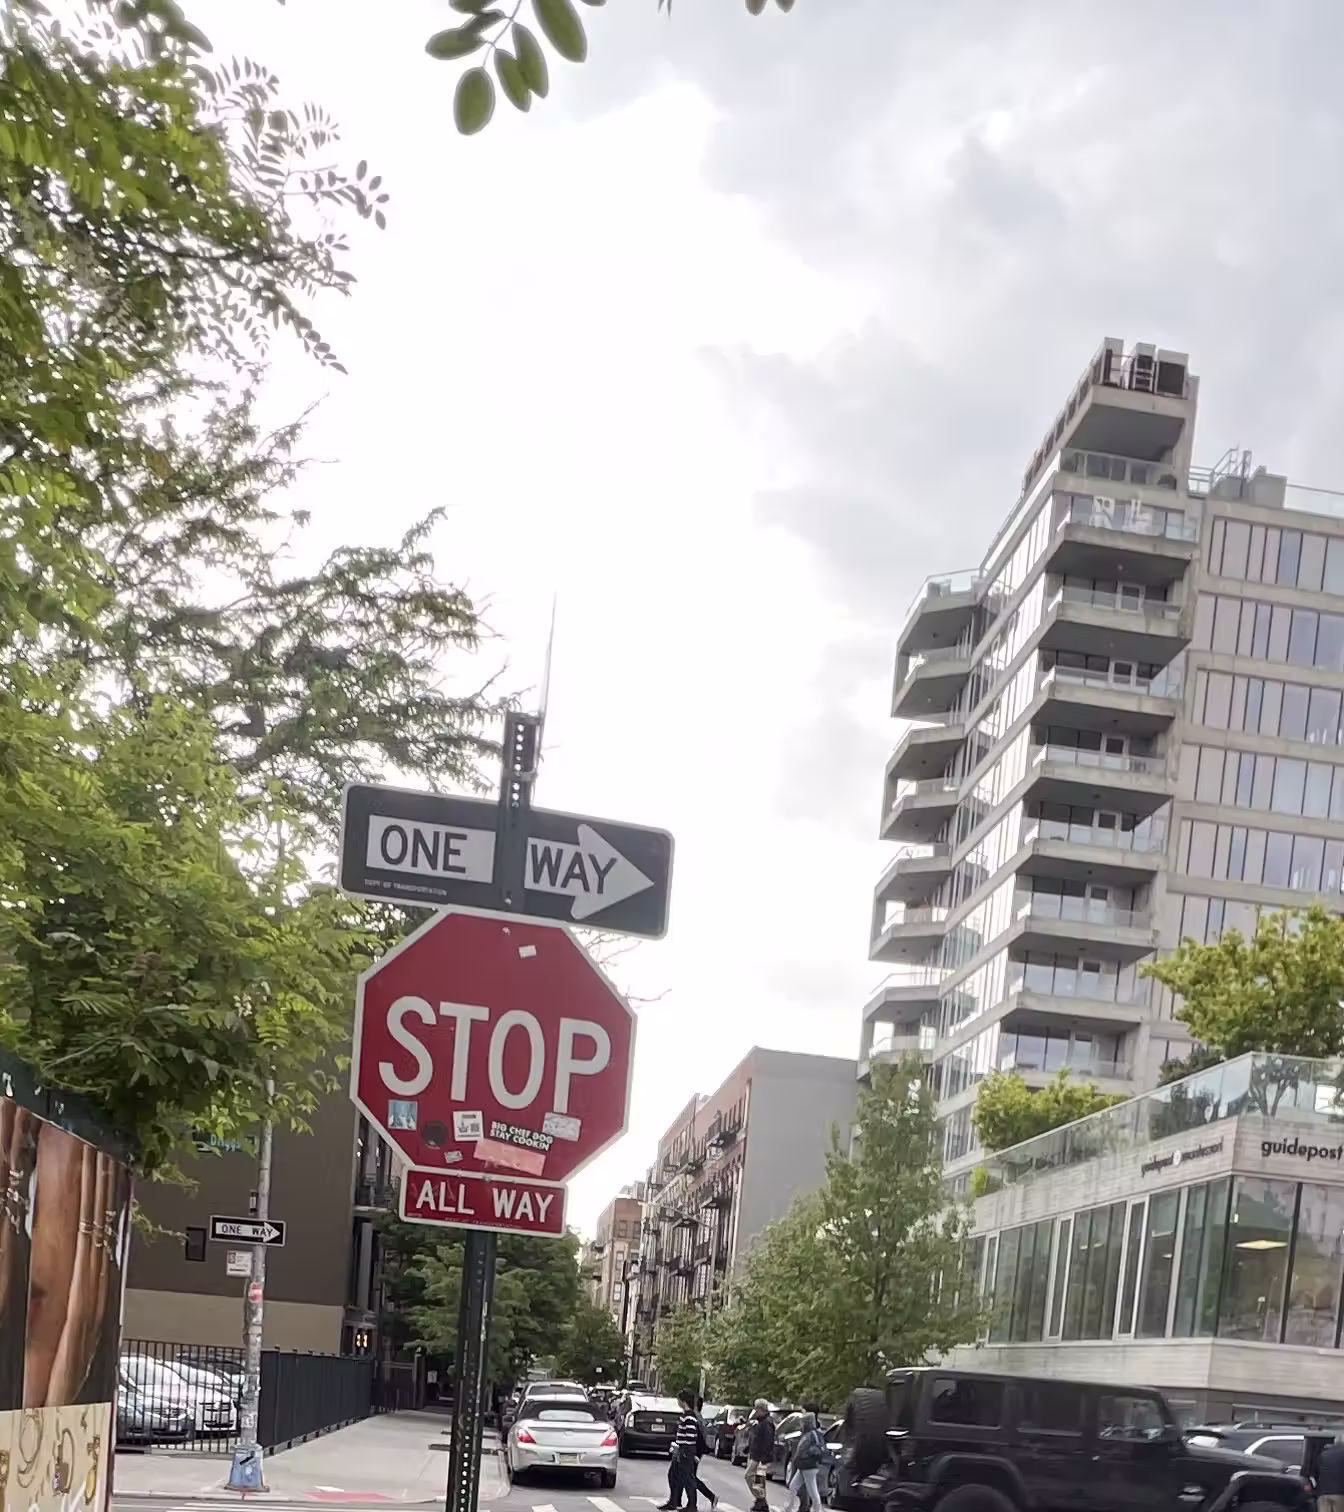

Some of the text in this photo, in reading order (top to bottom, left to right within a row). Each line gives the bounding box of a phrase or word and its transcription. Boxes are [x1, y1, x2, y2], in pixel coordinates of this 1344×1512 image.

[380, 824, 617, 895] ONE WAY
[378, 995, 612, 1114] STOP
[490, 1129, 550, 1152] STAY COOKIN
[491, 1120, 508, 1131] BIG
[509, 1126, 531, 1138] CHEF
[532, 1132, 554, 1145] DOG
[1261, 1137, 1343, 1161] guidepost
[415, 1179, 554, 1223] ALL WAY
[221, 1223, 273, 1238] ONE WAY
